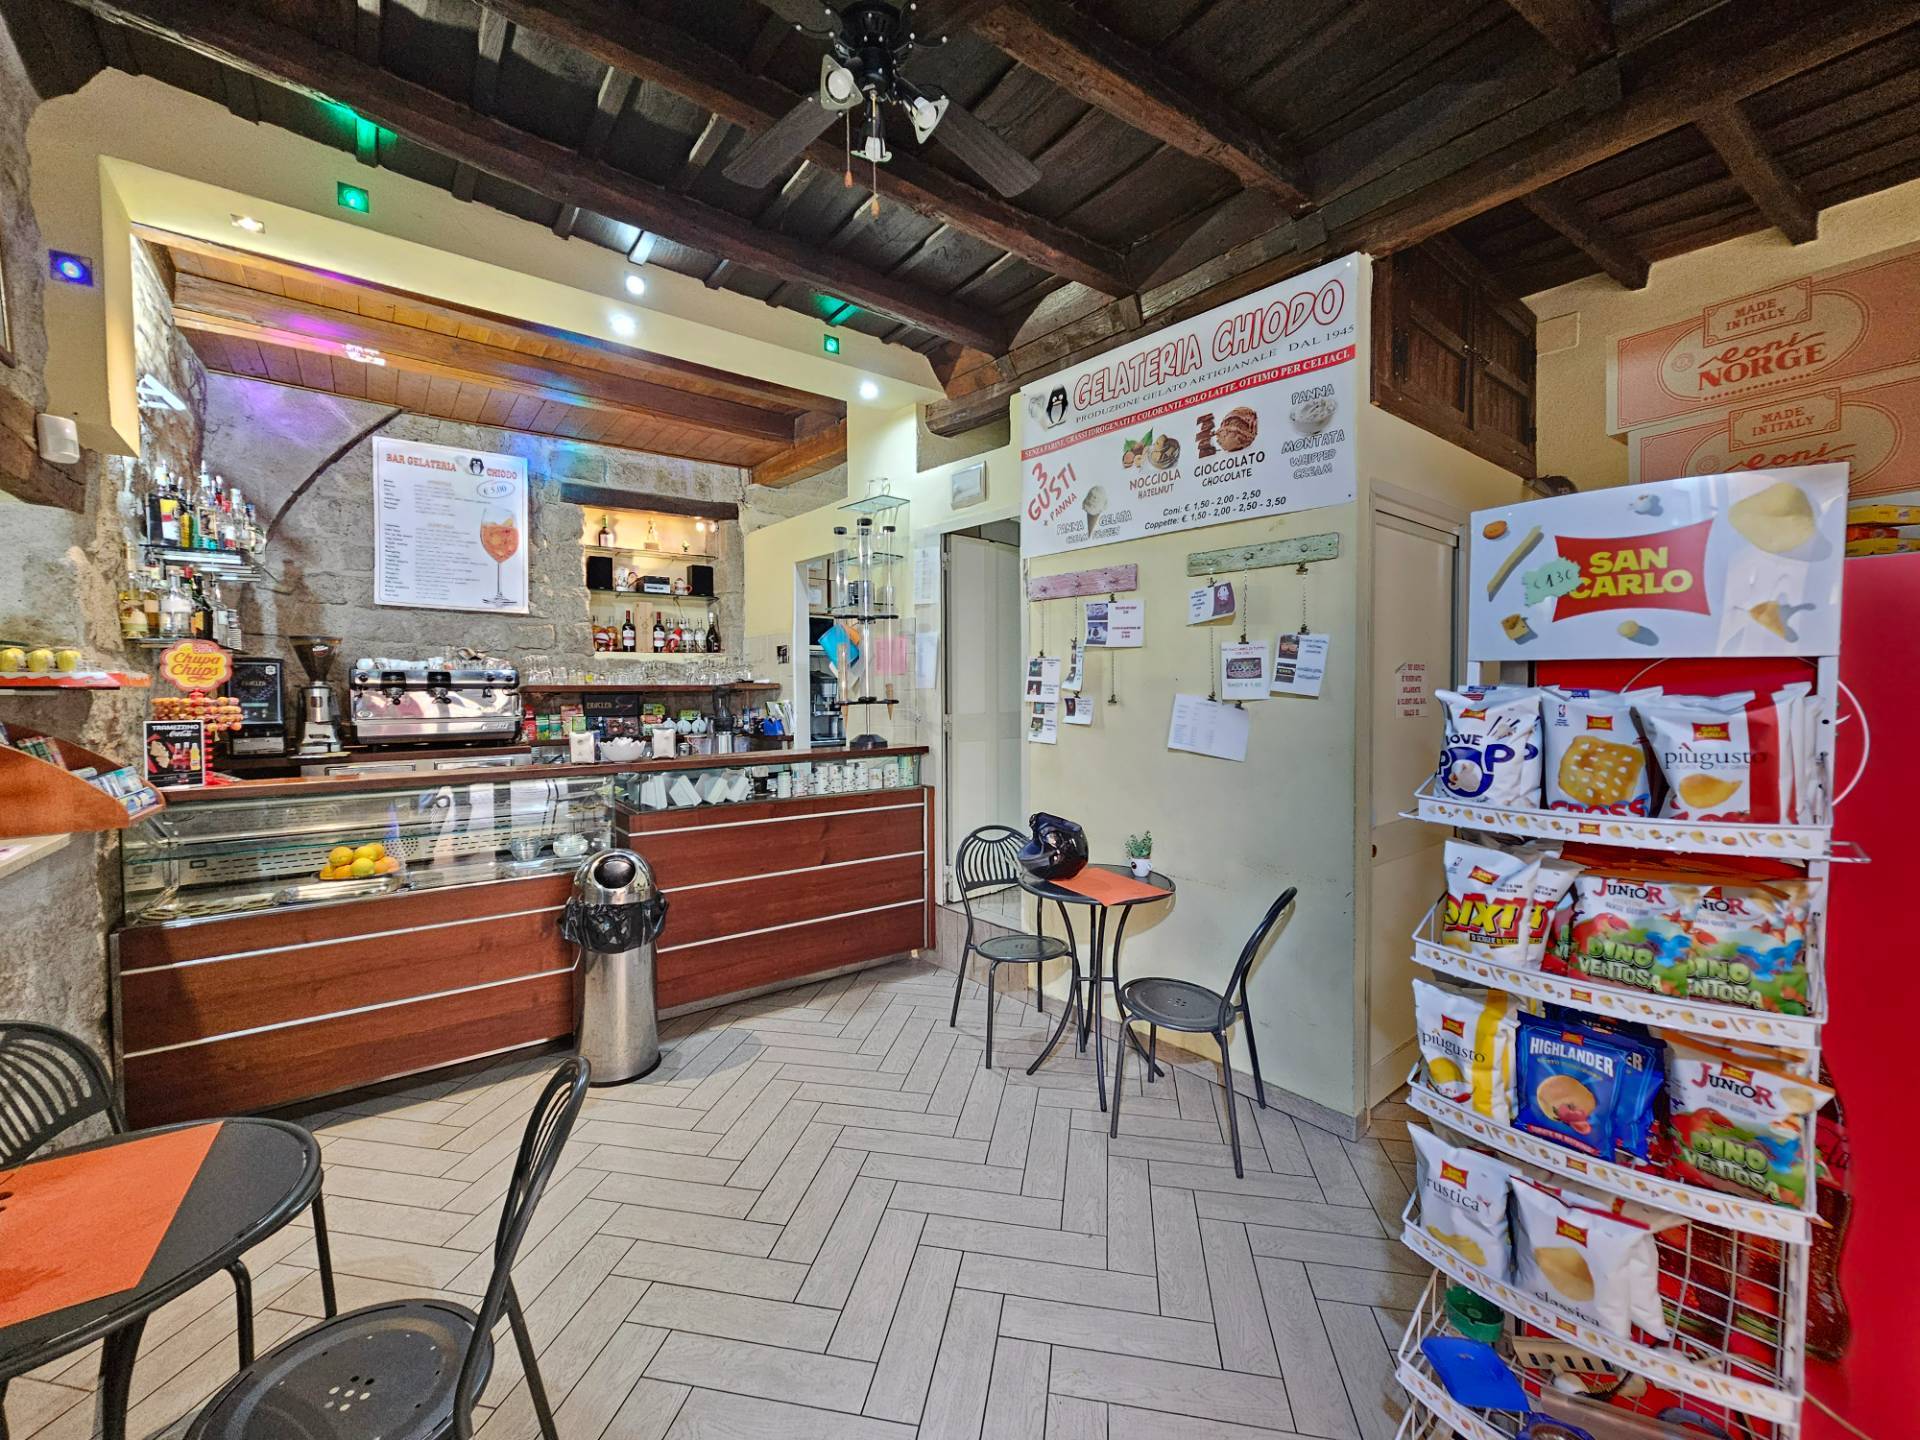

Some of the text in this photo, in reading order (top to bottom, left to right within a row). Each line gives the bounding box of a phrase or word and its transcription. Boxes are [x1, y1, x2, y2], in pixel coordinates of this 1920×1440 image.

[1726, 306, 1787, 331] IN ITALY
[1735, 298, 1776, 318] MADE
[1073, 279, 1345, 411] GELATERIA CHIODO
[1076, 324, 1354, 424] PRODUZIONE GELATO ARTIGIANALE DAL 1945
[1698, 342, 1826, 391] NORGE
[1184, 392, 1207, 406] SOLO
[1239, 369, 1279, 387] OTTIMO
[1280, 363, 1301, 377] PER
[1291, 384, 1335, 405] PANNA
[1752, 415, 1815, 436] IN ITALY
[1761, 406, 1805, 423] MADE
[1281, 429, 1345, 455] MONTATA
[386, 453, 518, 480] BAR GELATERIA CHIODO
[1193, 450, 1265, 478] CIOCCOLATO
[1289, 448, 1337, 468] WHIPPED
[1293, 463, 1333, 480] CREAM
[1032, 462, 1048, 489] 3
[1129, 468, 1181, 491] NOCCIOLA
[1201, 467, 1253, 487] CHOCOLATE
[1028, 462, 1077, 521] GUSTI
[1137, 483, 1175, 500] HAZELNUT
[1163, 489, 1261, 517] Coni: € 1,50 2,00 2,50
[1050, 492, 1078, 521] PANNA
[1144, 496, 1287, 530] Coppette: € 1,50 2,00 2,50 3,50
[1589, 546, 1668, 574] SAN
[1569, 569, 1693, 599] CARLO
[171, 663, 219, 678] Chups
[174, 652, 220, 666] Chupa
[1664, 742, 1768, 770] piùgusto
[1593, 878, 1666, 906] JUNIOR
[1588, 936, 1655, 969] DINO
[1579, 956, 1662, 993] VENTOSA
[1529, 1036, 1614, 1078] HIGHLANDER
[1691, 1063, 1776, 1110] JUNIOR
[1691, 1131, 1769, 1175] DINO
[1684, 1148, 1780, 1201] VENTOSA
[1426, 1176, 1480, 1213] rustica
[1534, 1290, 1600, 1327] classica
